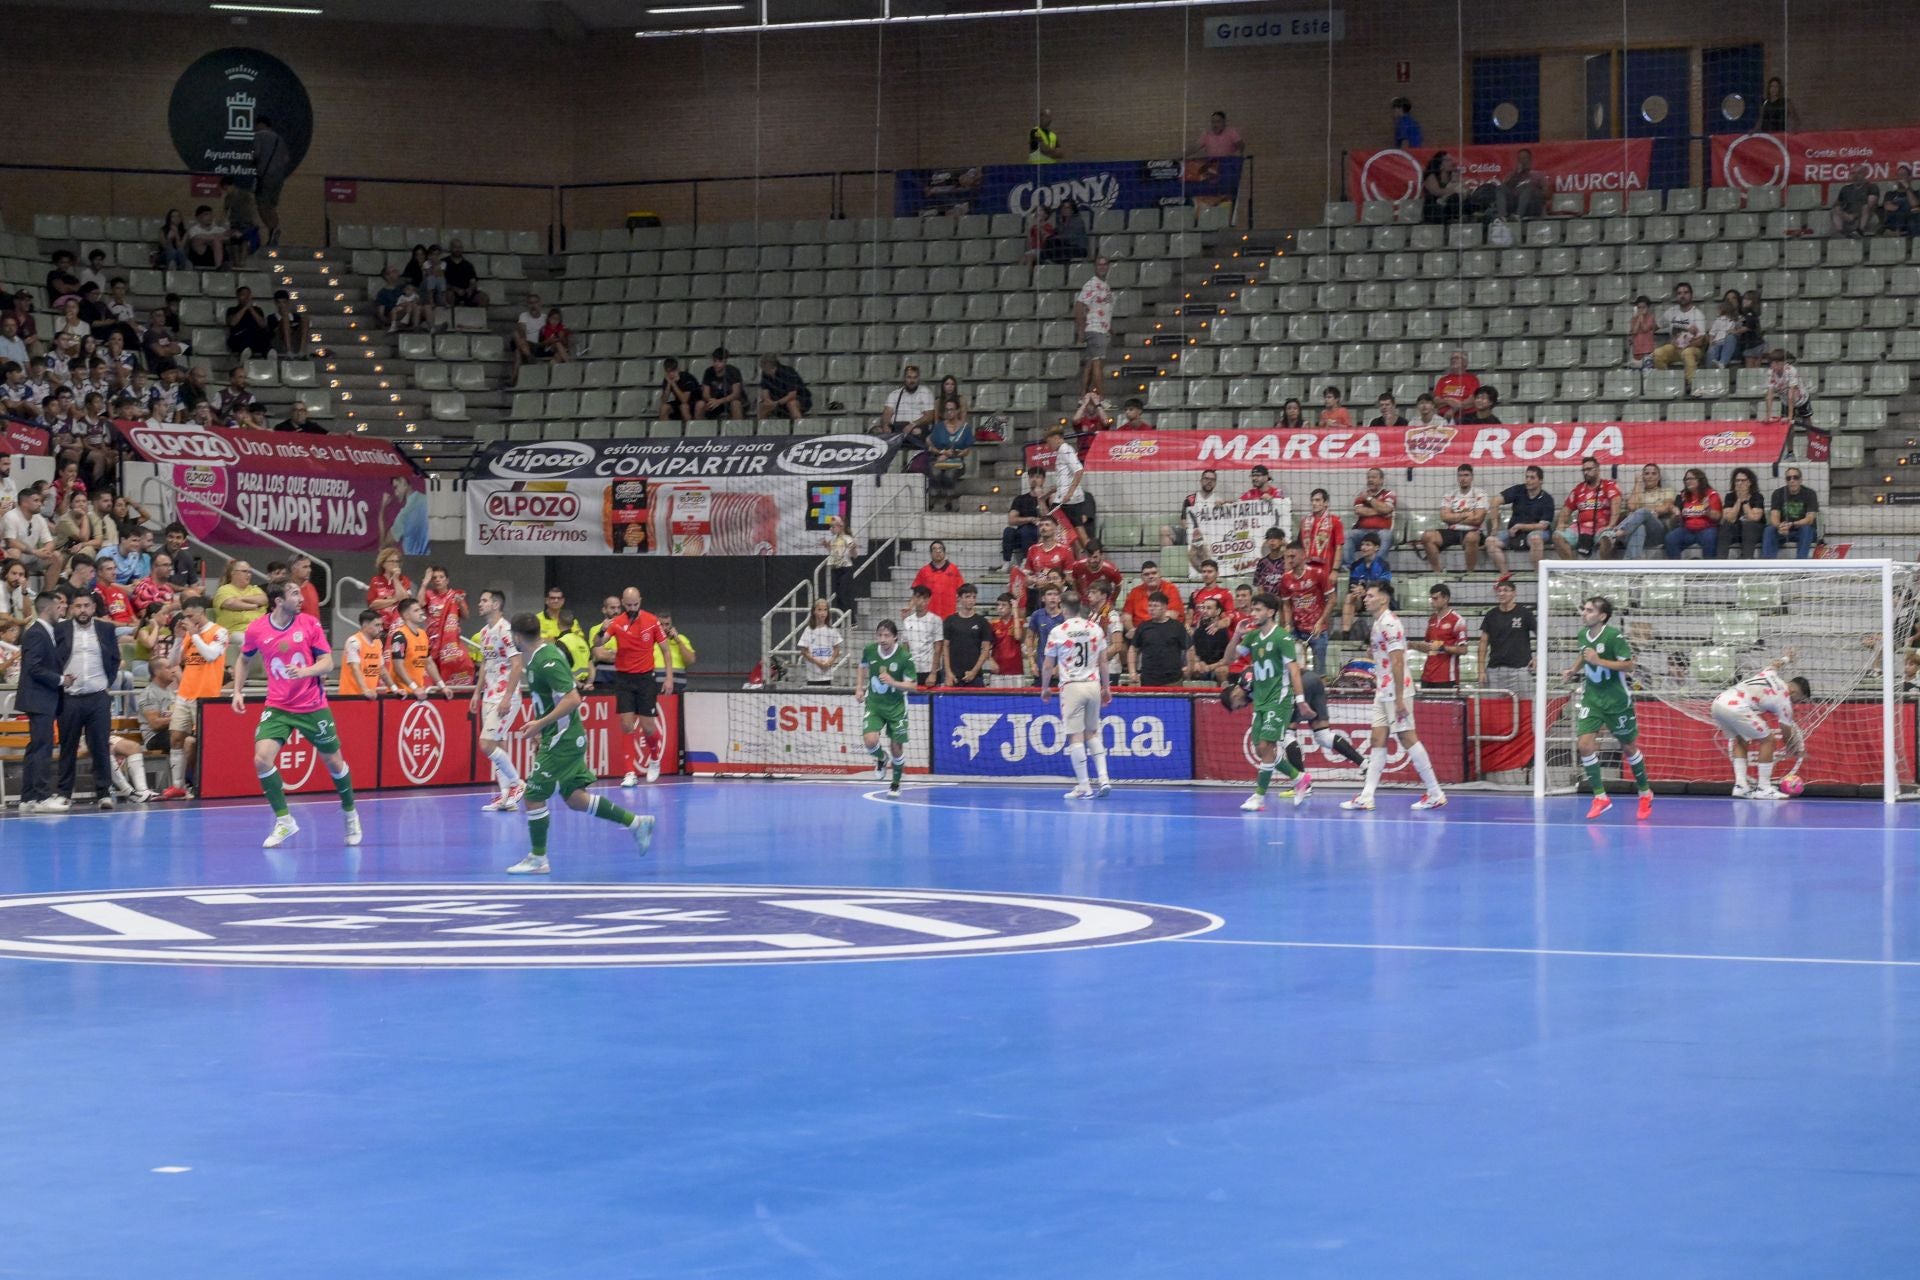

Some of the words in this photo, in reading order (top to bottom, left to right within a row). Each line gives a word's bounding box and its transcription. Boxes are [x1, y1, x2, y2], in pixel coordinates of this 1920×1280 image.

[1217, 21, 1282, 39] Grada
[1291, 18, 1330, 35] Este
[204, 149, 255, 162] Ayuntami
[215, 165, 229, 175] de
[231, 164, 258, 176] Murc
[1555, 171, 1641, 192] MURCIA
[234, 437, 273, 457] Uno
[277, 441, 312, 459] más
[314, 444, 330, 460] de
[330, 444, 347, 461] la
[346, 445, 403, 466] familia
[1197, 433, 1382, 460] MAREA
[1470, 427, 1625, 459] ROJA
[500, 450, 590, 472] Fripozo
[603, 443, 670, 456] estamos
[674, 440, 732, 454] hechos
[733, 442, 776, 456] para
[787, 443, 882, 467] Fripozo
[595, 455, 768, 476] COMPARTIR
[237, 472, 264, 492] PARA
[265, 475, 285, 494] LOS
[286, 475, 307, 495] QUE
[236, 492, 322, 535] SIEMPRE
[1200, 501, 1274, 521] ALCANTARILLA
[479, 522, 524, 545] Extra
[527, 524, 587, 542] Tiernos
[1234, 520, 1249, 531] CON
[1251, 519, 1261, 529] EL
[1075, 641, 1088, 667] 31
[779, 705, 844, 732] STM
[413, 727, 431, 740] RF
[280, 750, 306, 769] EF
[413, 744, 431, 756] EF
